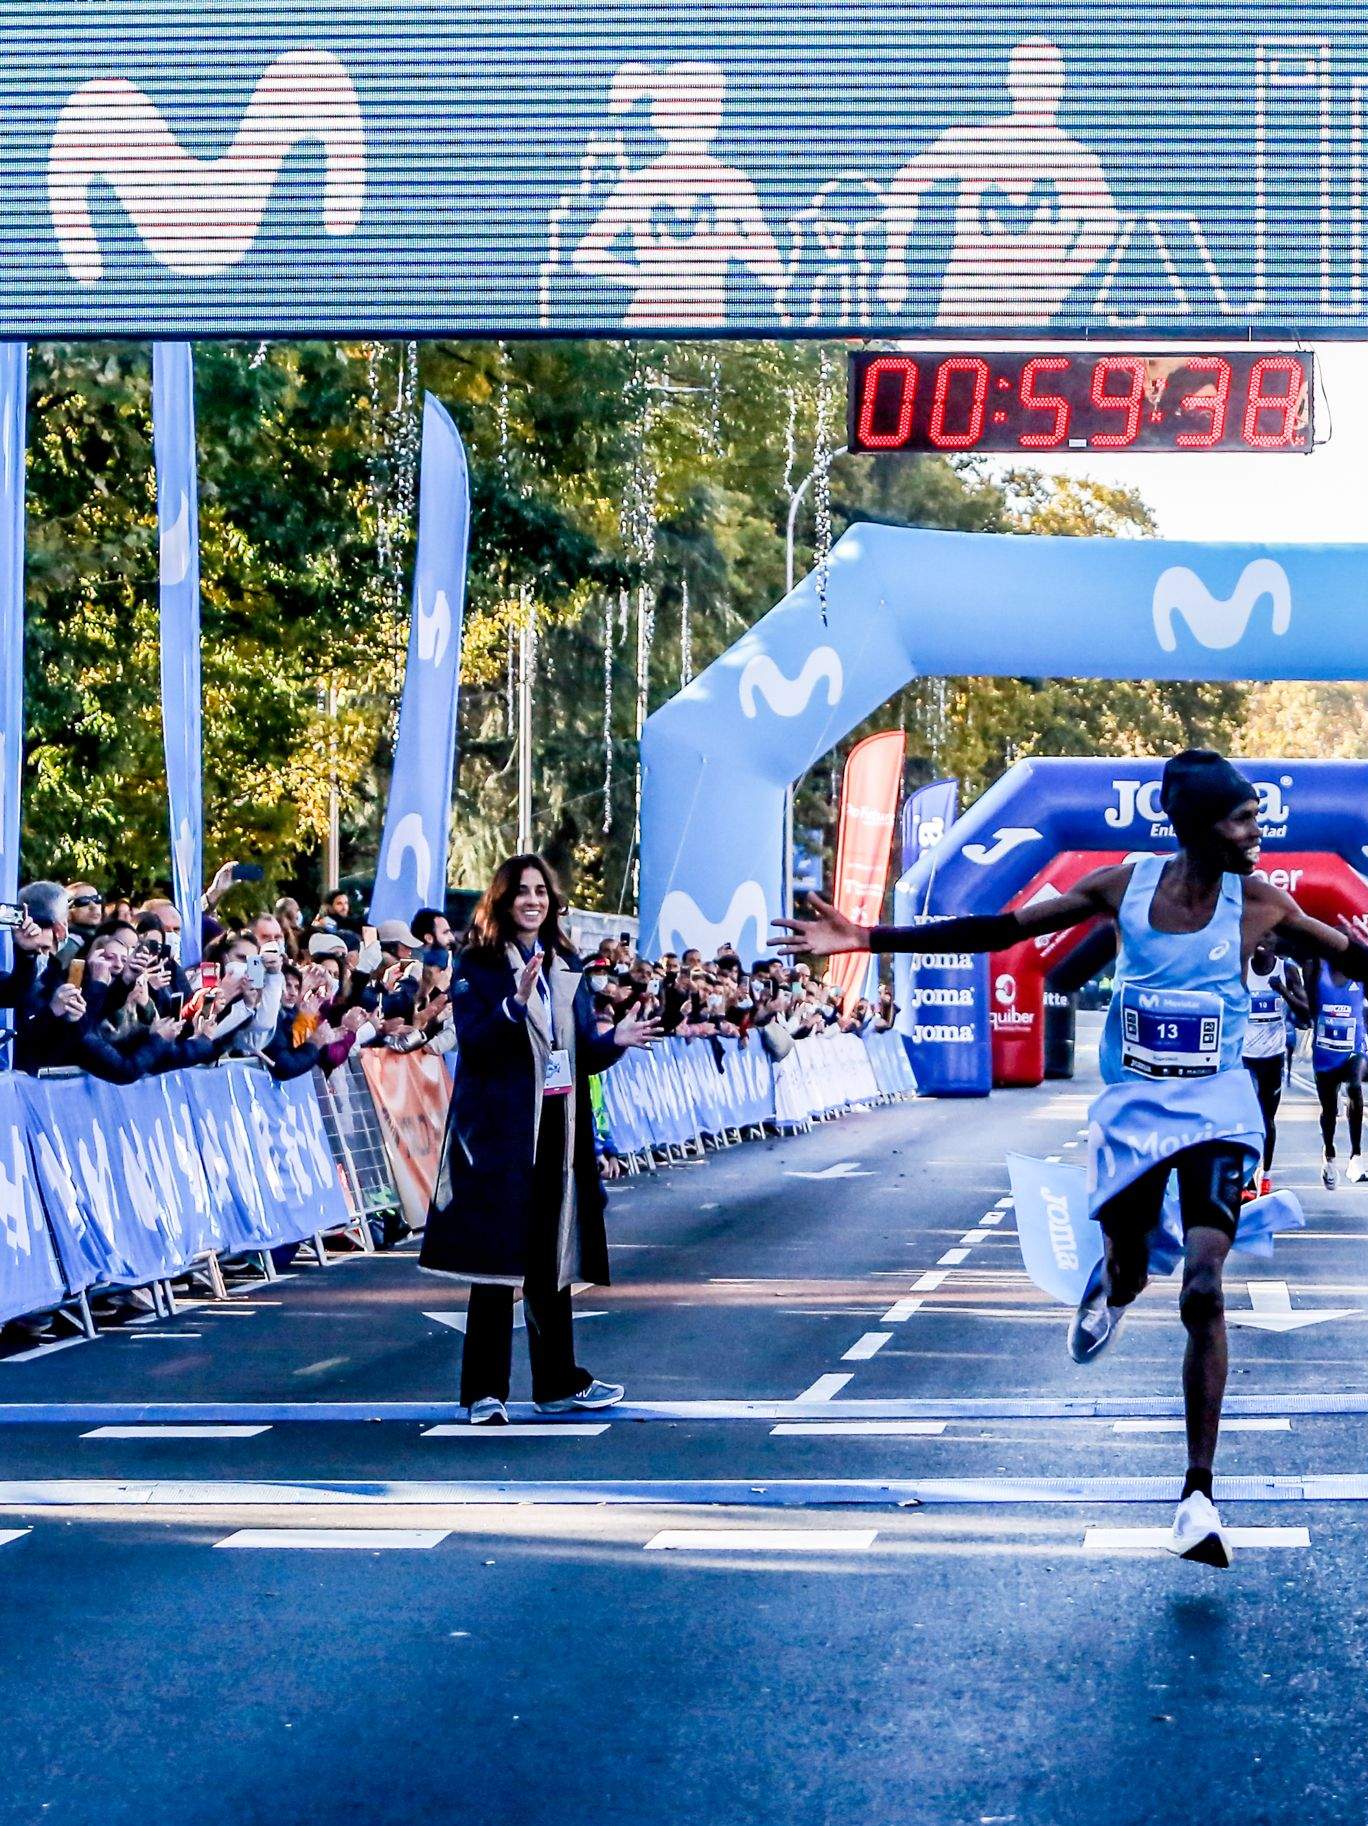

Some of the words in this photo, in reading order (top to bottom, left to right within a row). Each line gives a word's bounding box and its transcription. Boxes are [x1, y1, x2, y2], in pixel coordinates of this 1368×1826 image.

[1104, 780, 1289, 828] Joa
[990, 1005, 1034, 1032] quiber
[1157, 1023, 1179, 1039] 13
